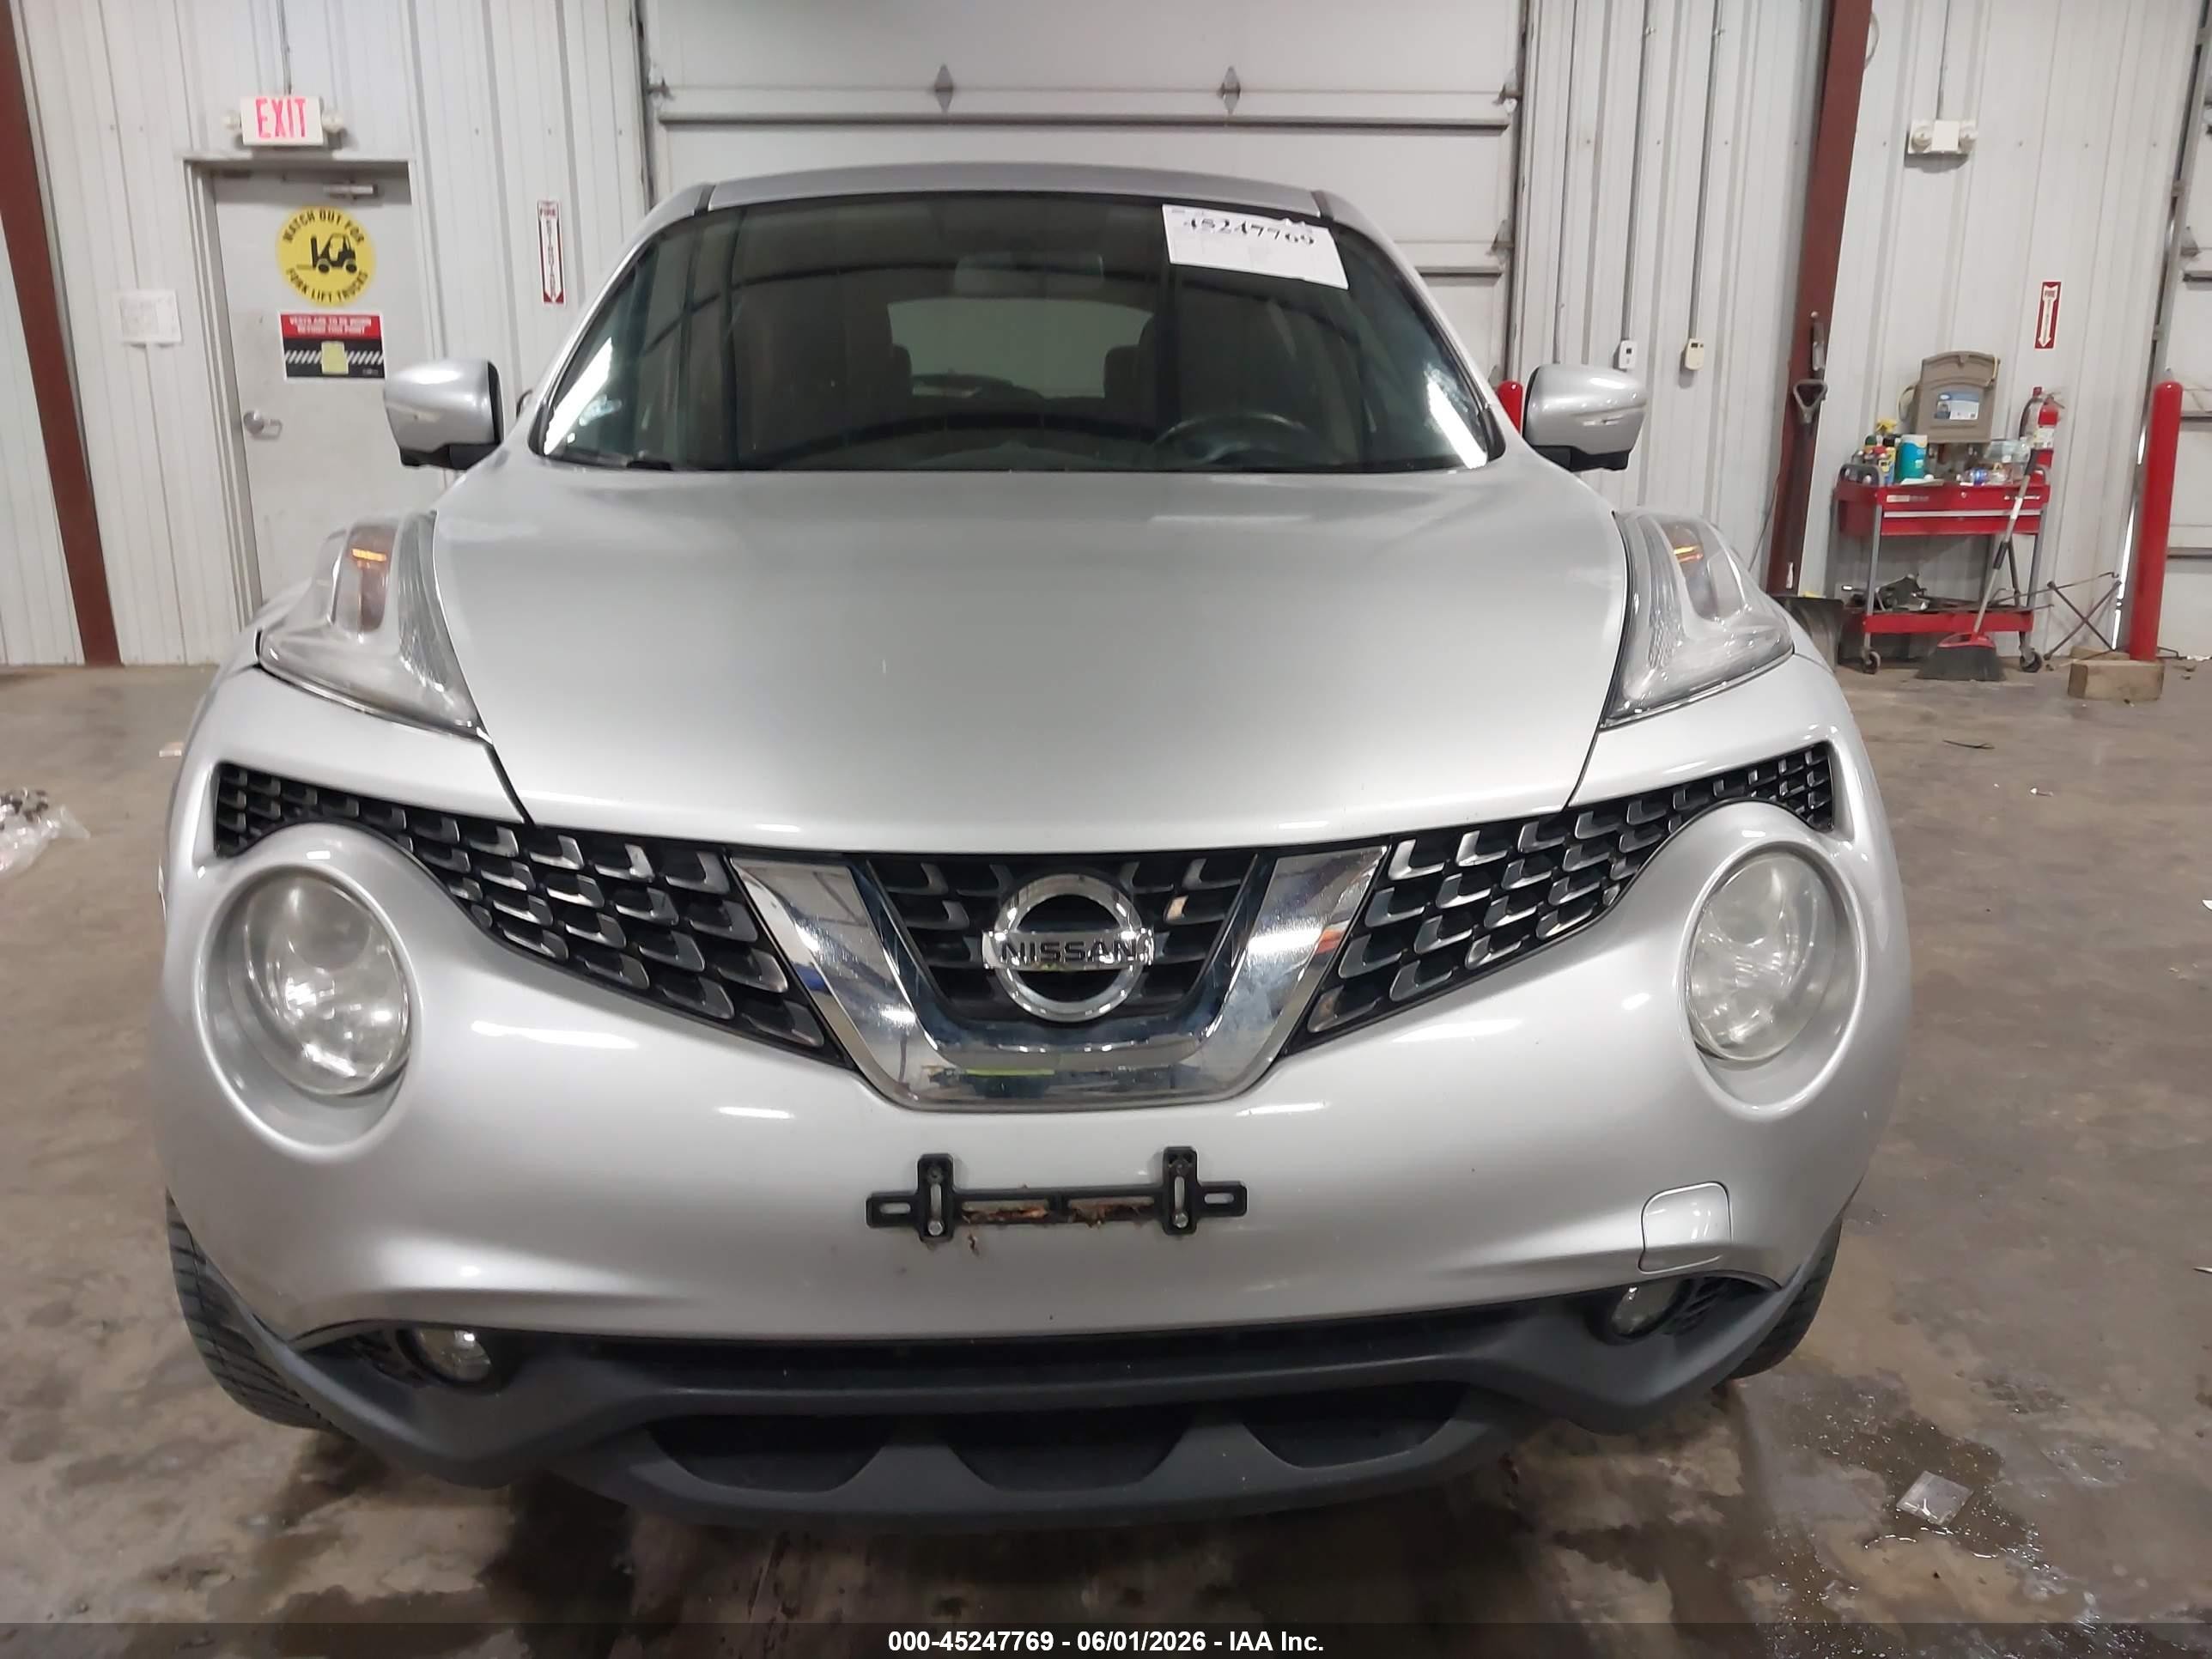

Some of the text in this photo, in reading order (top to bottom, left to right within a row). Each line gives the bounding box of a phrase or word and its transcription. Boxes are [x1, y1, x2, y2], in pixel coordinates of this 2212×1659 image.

[255, 98, 306, 137] EXIT
[283, 209, 365, 245] WATCH OUT FOR
[287, 267, 368, 303] FORK LIFT TRUCKS
[1000, 939, 1136, 963] NISSAN
